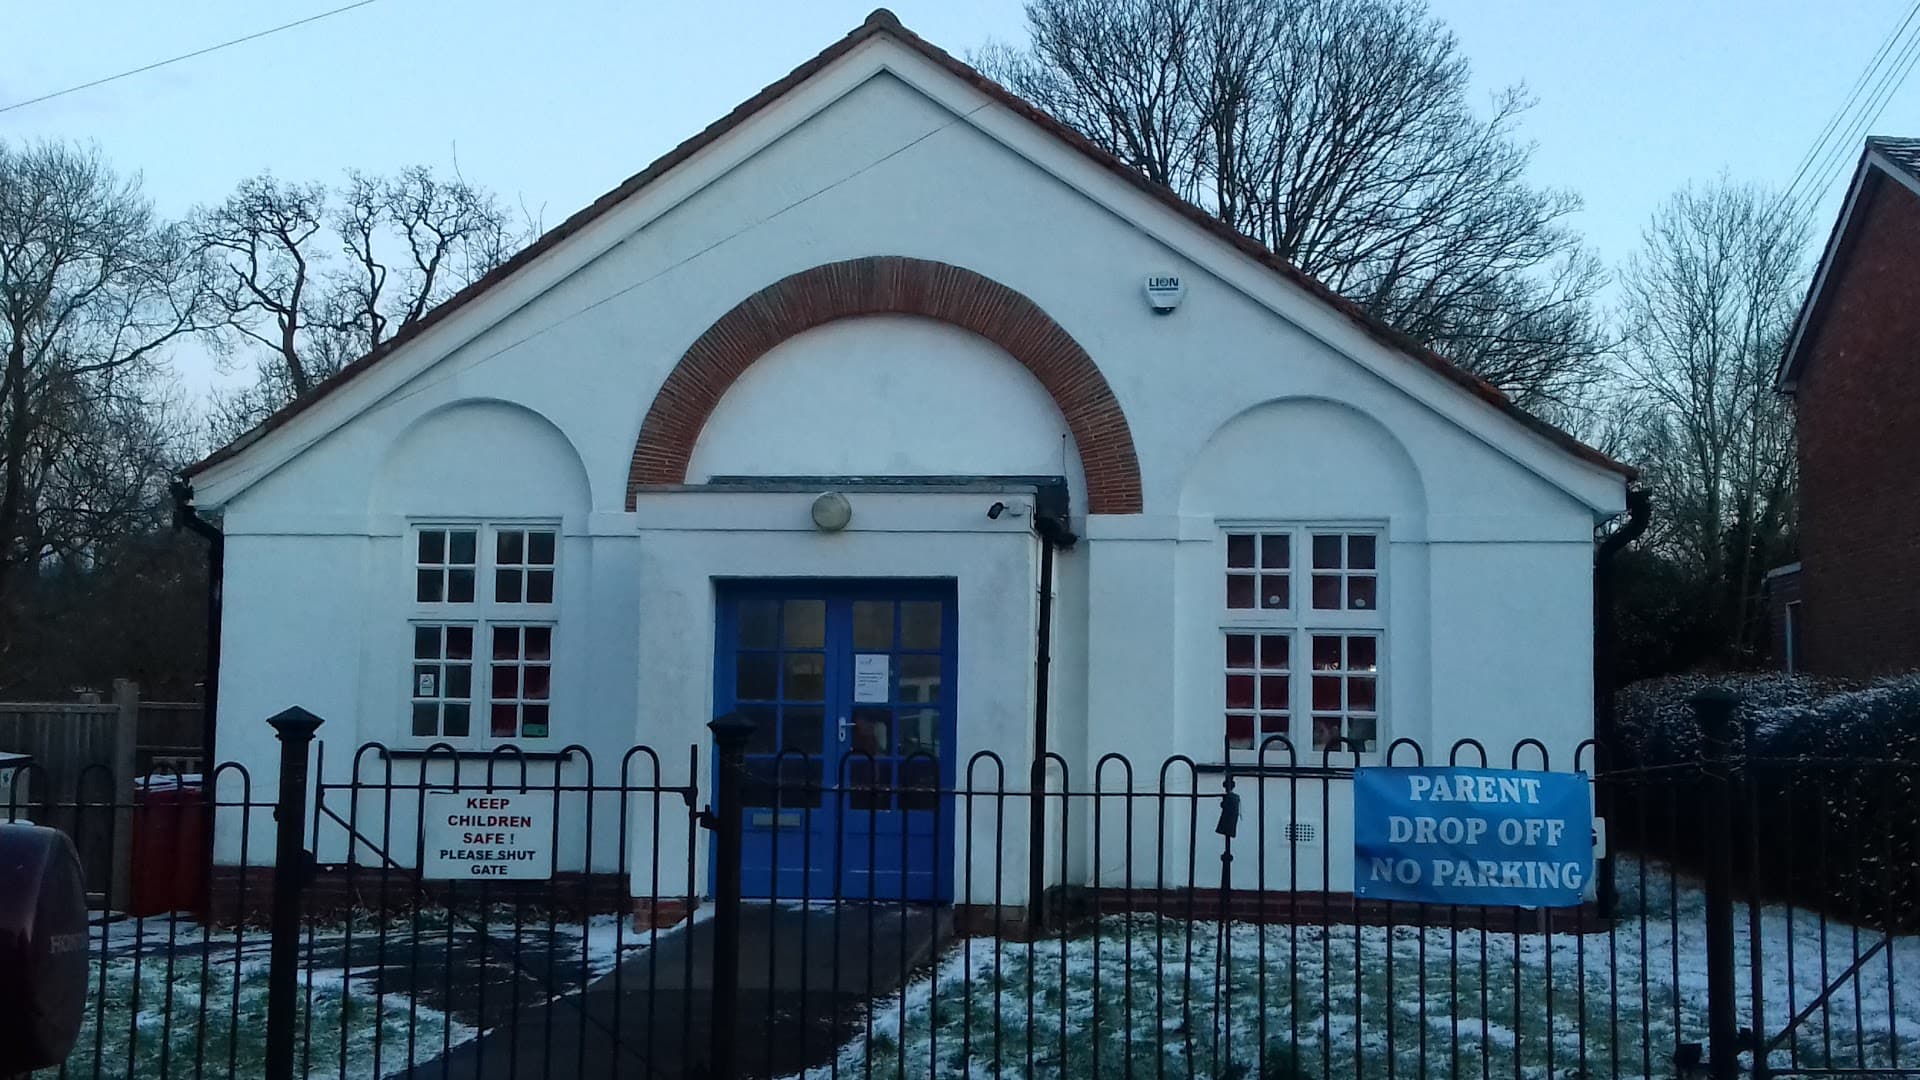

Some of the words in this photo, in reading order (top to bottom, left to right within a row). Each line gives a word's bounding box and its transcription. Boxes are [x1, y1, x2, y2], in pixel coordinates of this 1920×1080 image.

[1149, 278, 1179, 287] LION
[1408, 775, 1541, 804] PARENT
[467, 798, 510, 810] KEEP
[448, 815, 532, 828] CHILDREN
[1388, 816, 1487, 845] DROP
[1498, 819, 1565, 847] OFF
[463, 832, 505, 844] SAFE
[440, 849, 494, 860] PLEASE
[498, 850, 536, 861] SHUT
[471, 865, 508, 875] GATE
[1370, 857, 1422, 884] NO
[1432, 859, 1583, 889] PARKING
